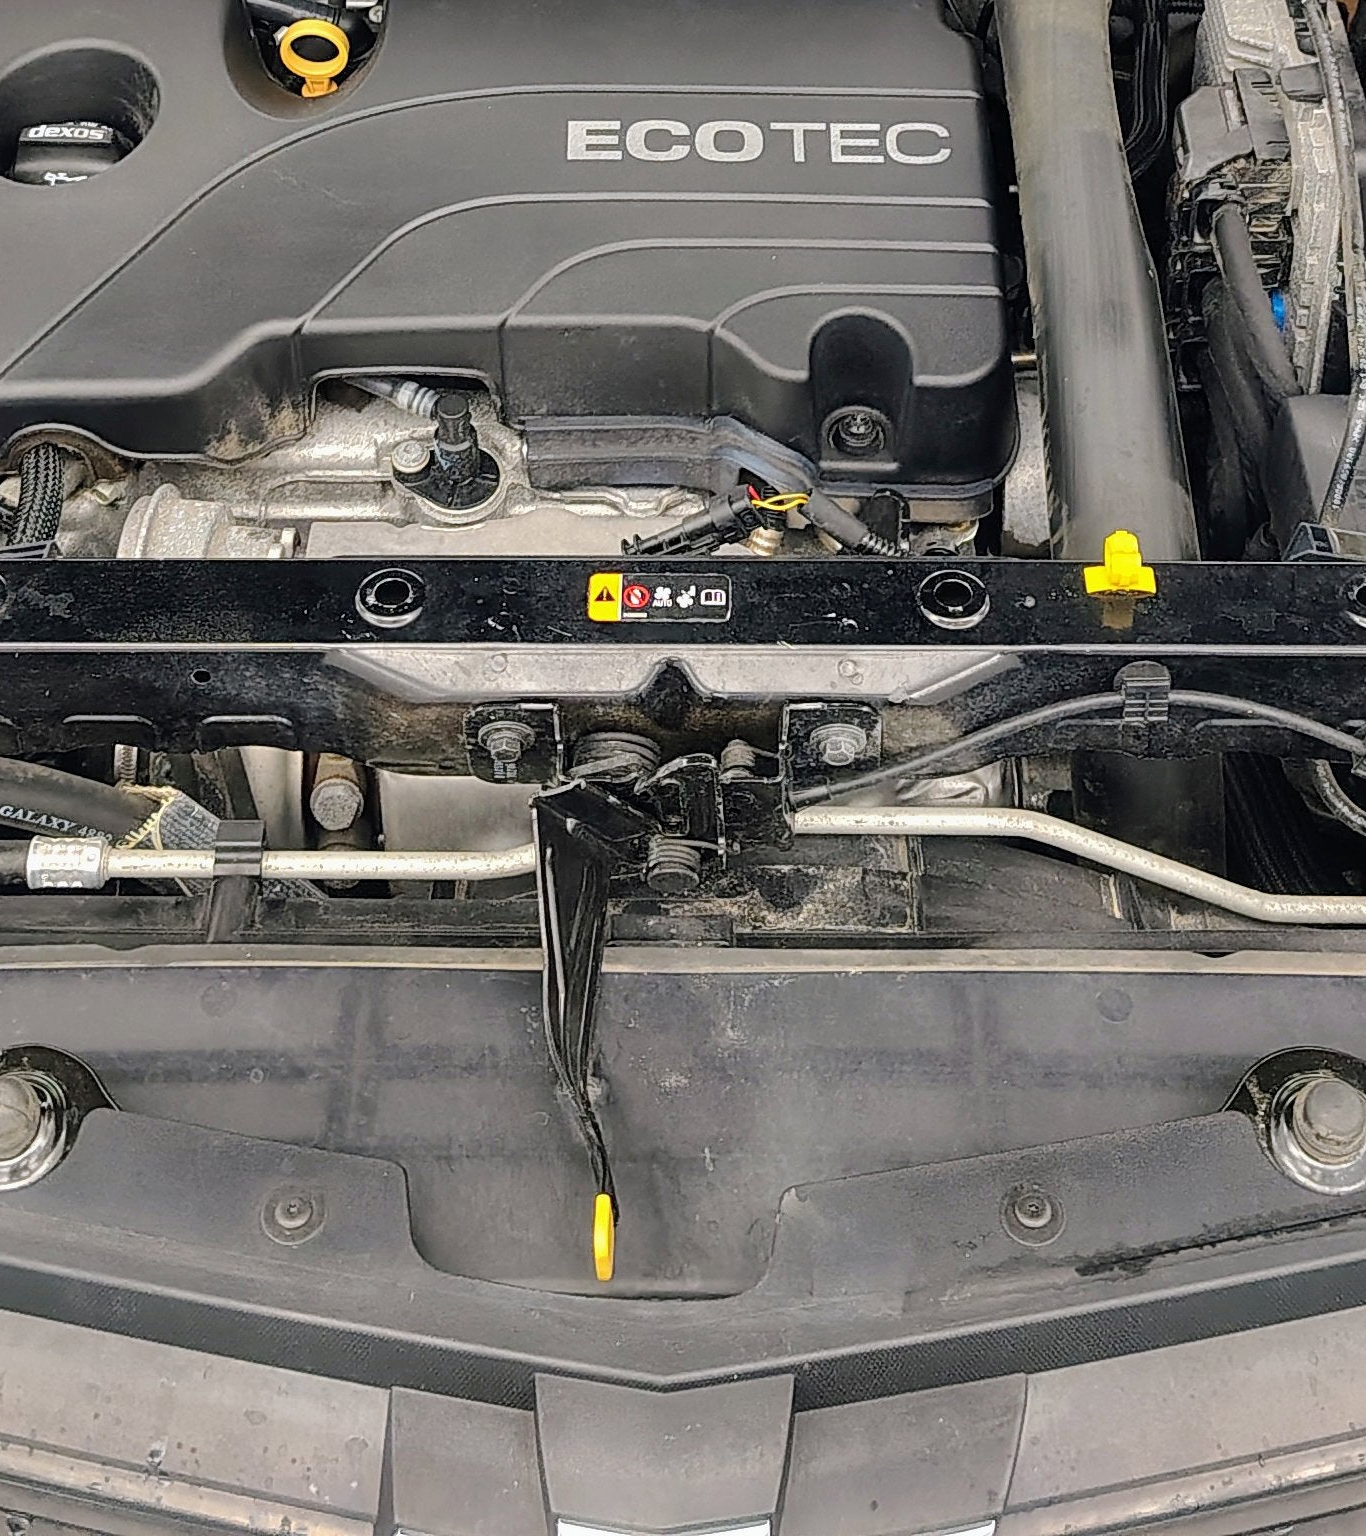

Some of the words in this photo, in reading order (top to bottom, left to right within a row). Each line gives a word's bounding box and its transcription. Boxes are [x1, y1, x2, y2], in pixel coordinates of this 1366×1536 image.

[28, 124, 104, 140] dexos
[565, 119, 952, 165] ECOTEC
[652, 599, 672, 608] AUTO
